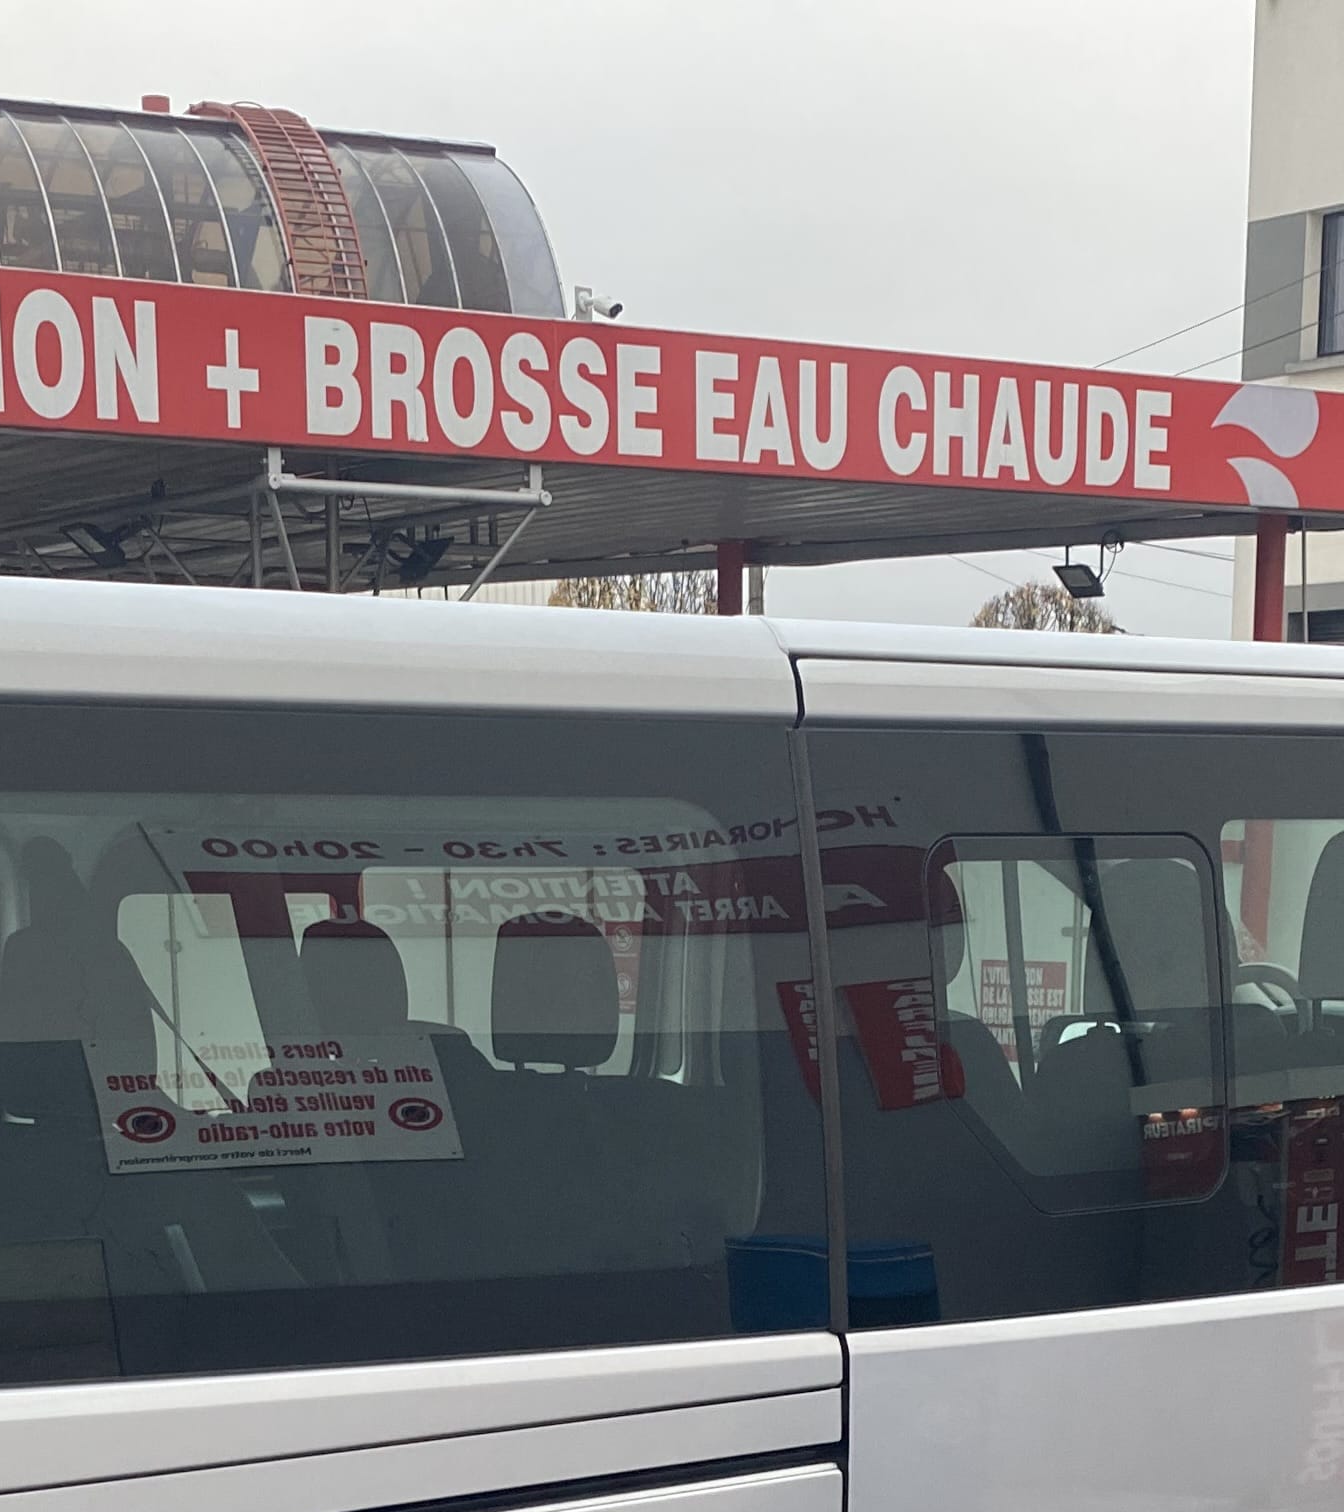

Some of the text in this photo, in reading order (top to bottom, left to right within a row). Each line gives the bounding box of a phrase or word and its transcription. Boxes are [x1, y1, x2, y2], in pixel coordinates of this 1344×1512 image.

[206, 329, 259, 429] +
[304, 315, 664, 459] BROSSE
[695, 350, 848, 471] EAU
[878, 365, 1172, 491] CHAUDE
[1047, 989, 1065, 1007] EST
